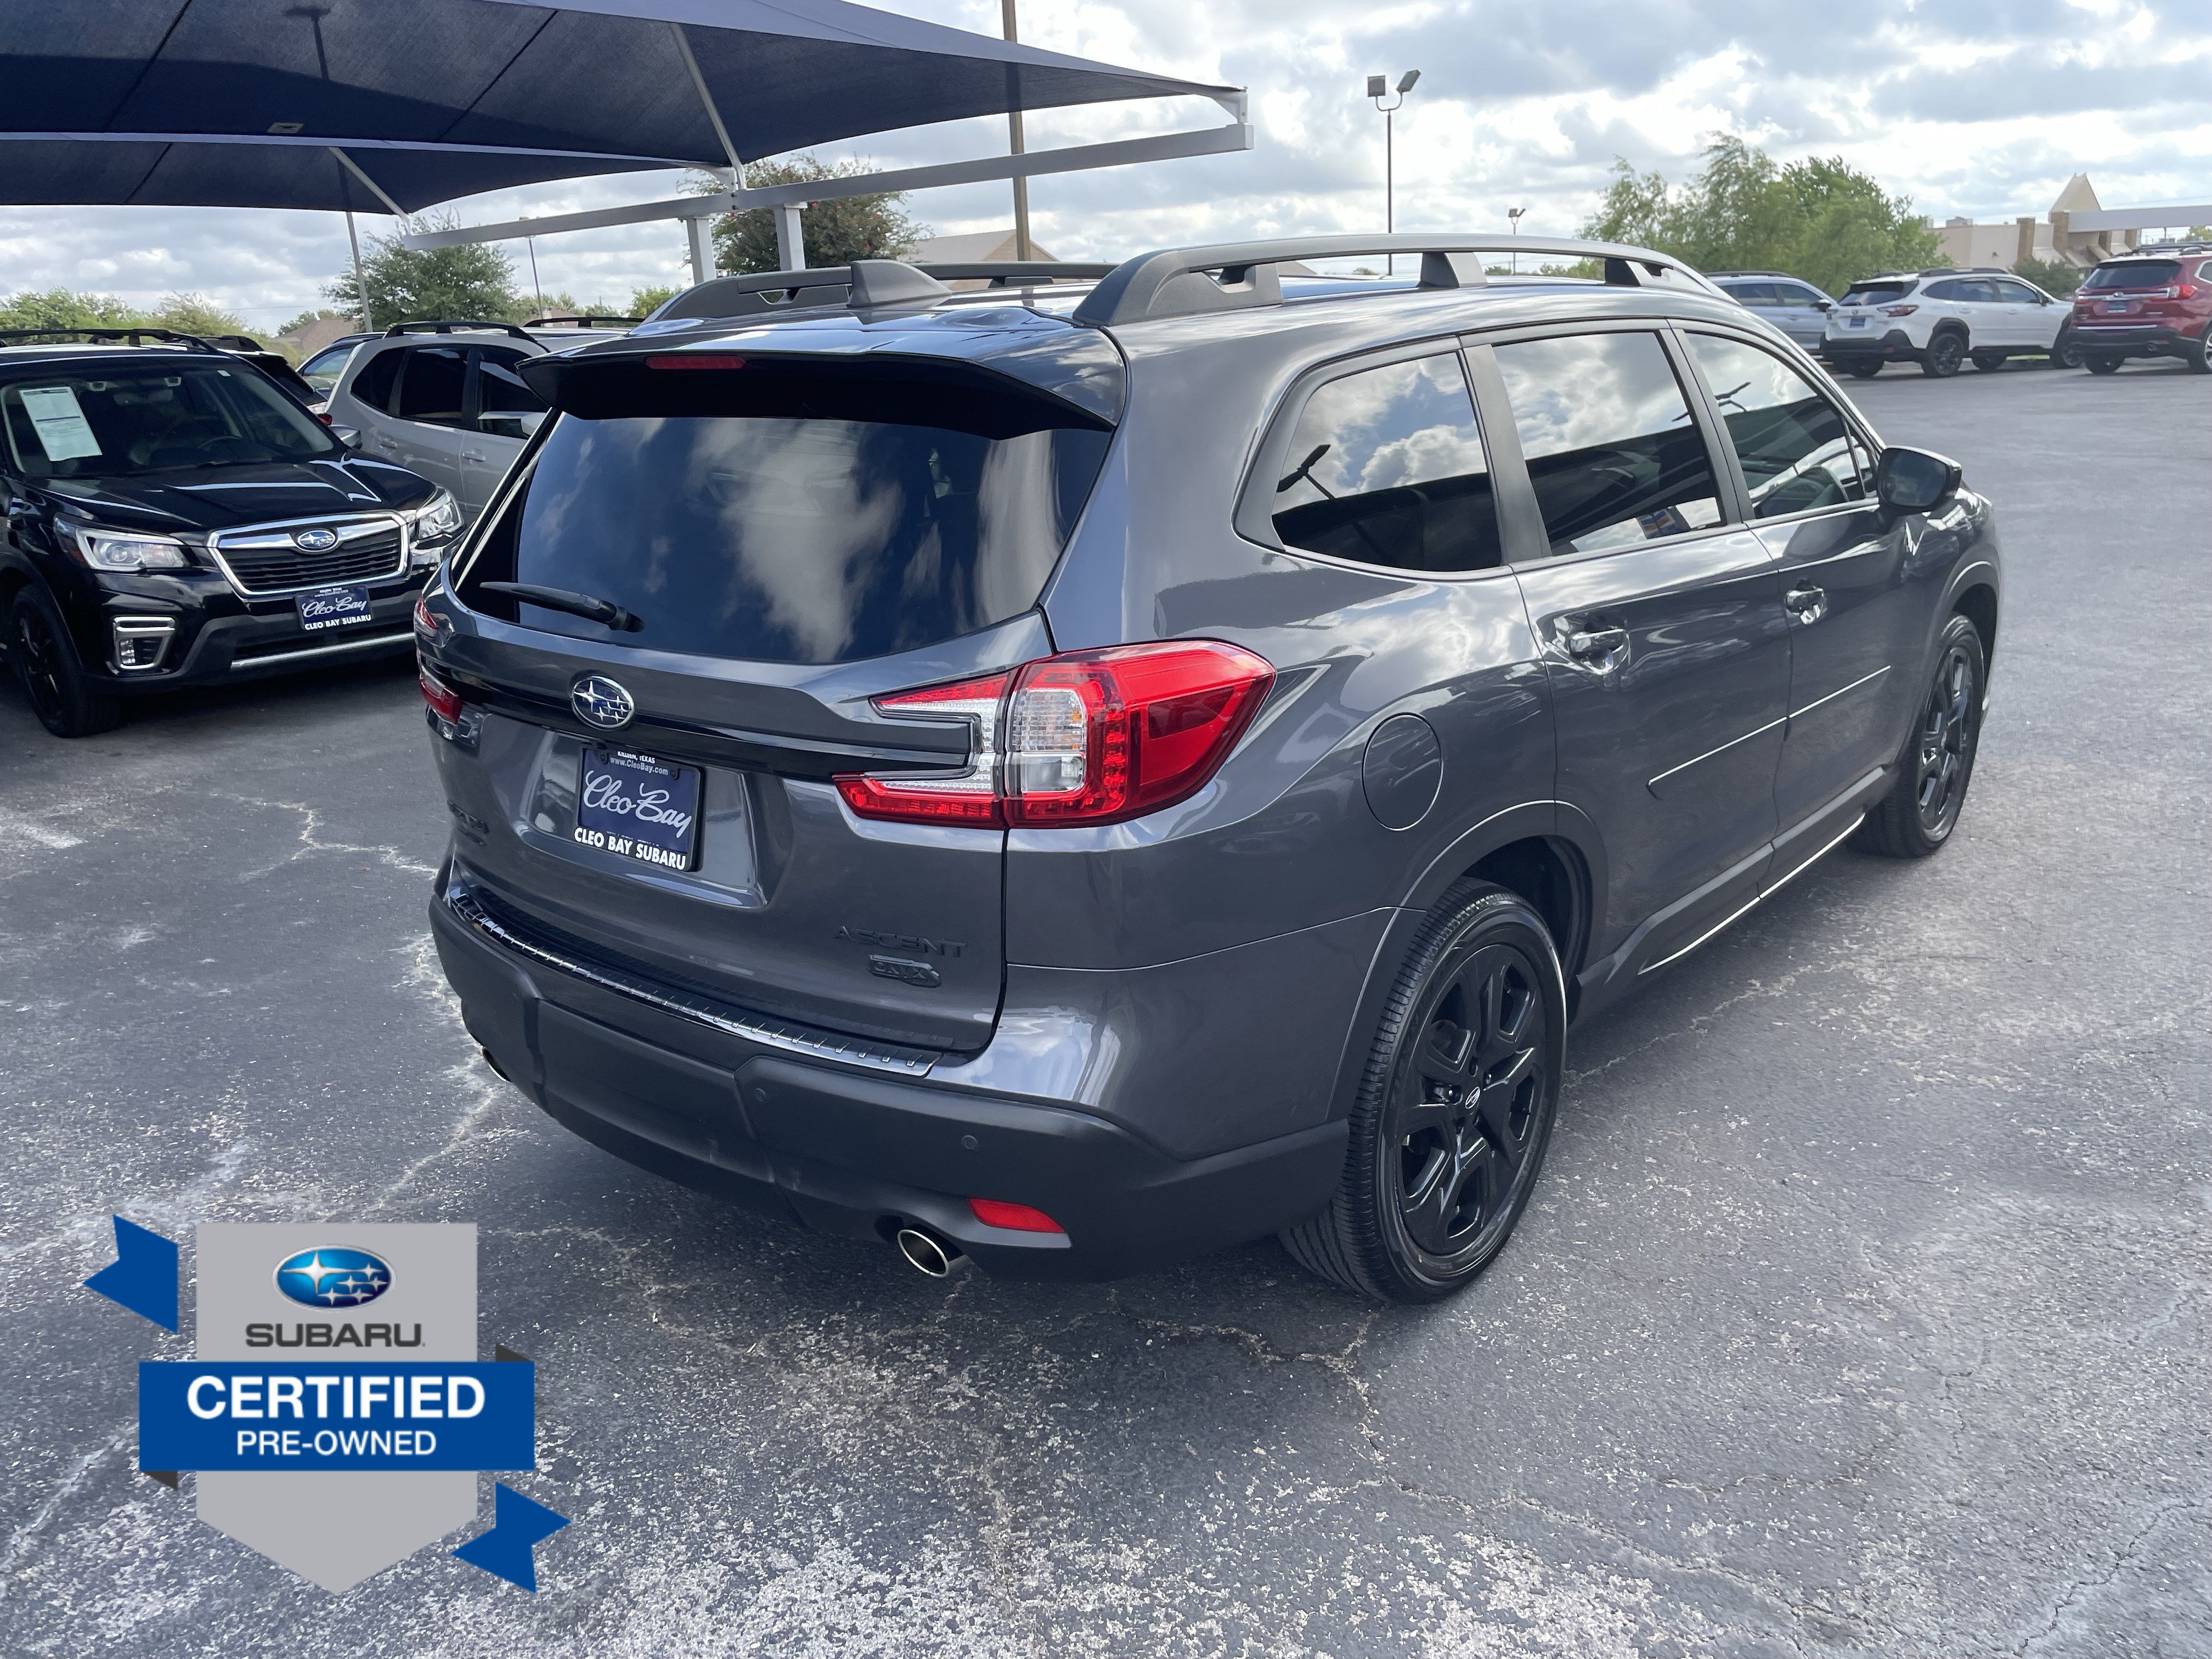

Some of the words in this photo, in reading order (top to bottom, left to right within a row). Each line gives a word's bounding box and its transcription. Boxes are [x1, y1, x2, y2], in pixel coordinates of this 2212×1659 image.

[302, 601, 336, 618] Cleo
[335, 596, 367, 611] Bay
[305, 622, 324, 630] CLEO
[326, 619, 340, 627] BAY
[342, 614, 371, 625] SUBARU
[610, 757, 668, 776] www.CleoBay.com
[639, 755, 655, 764] TEXAS
[584, 770, 636, 814] Cleo
[635, 782, 692, 838] Bay
[574, 827, 605, 848] CLEO
[608, 836, 633, 855] BAY
[635, 843, 686, 870] SUBARU
[834, 926, 968, 957] ASCENT
